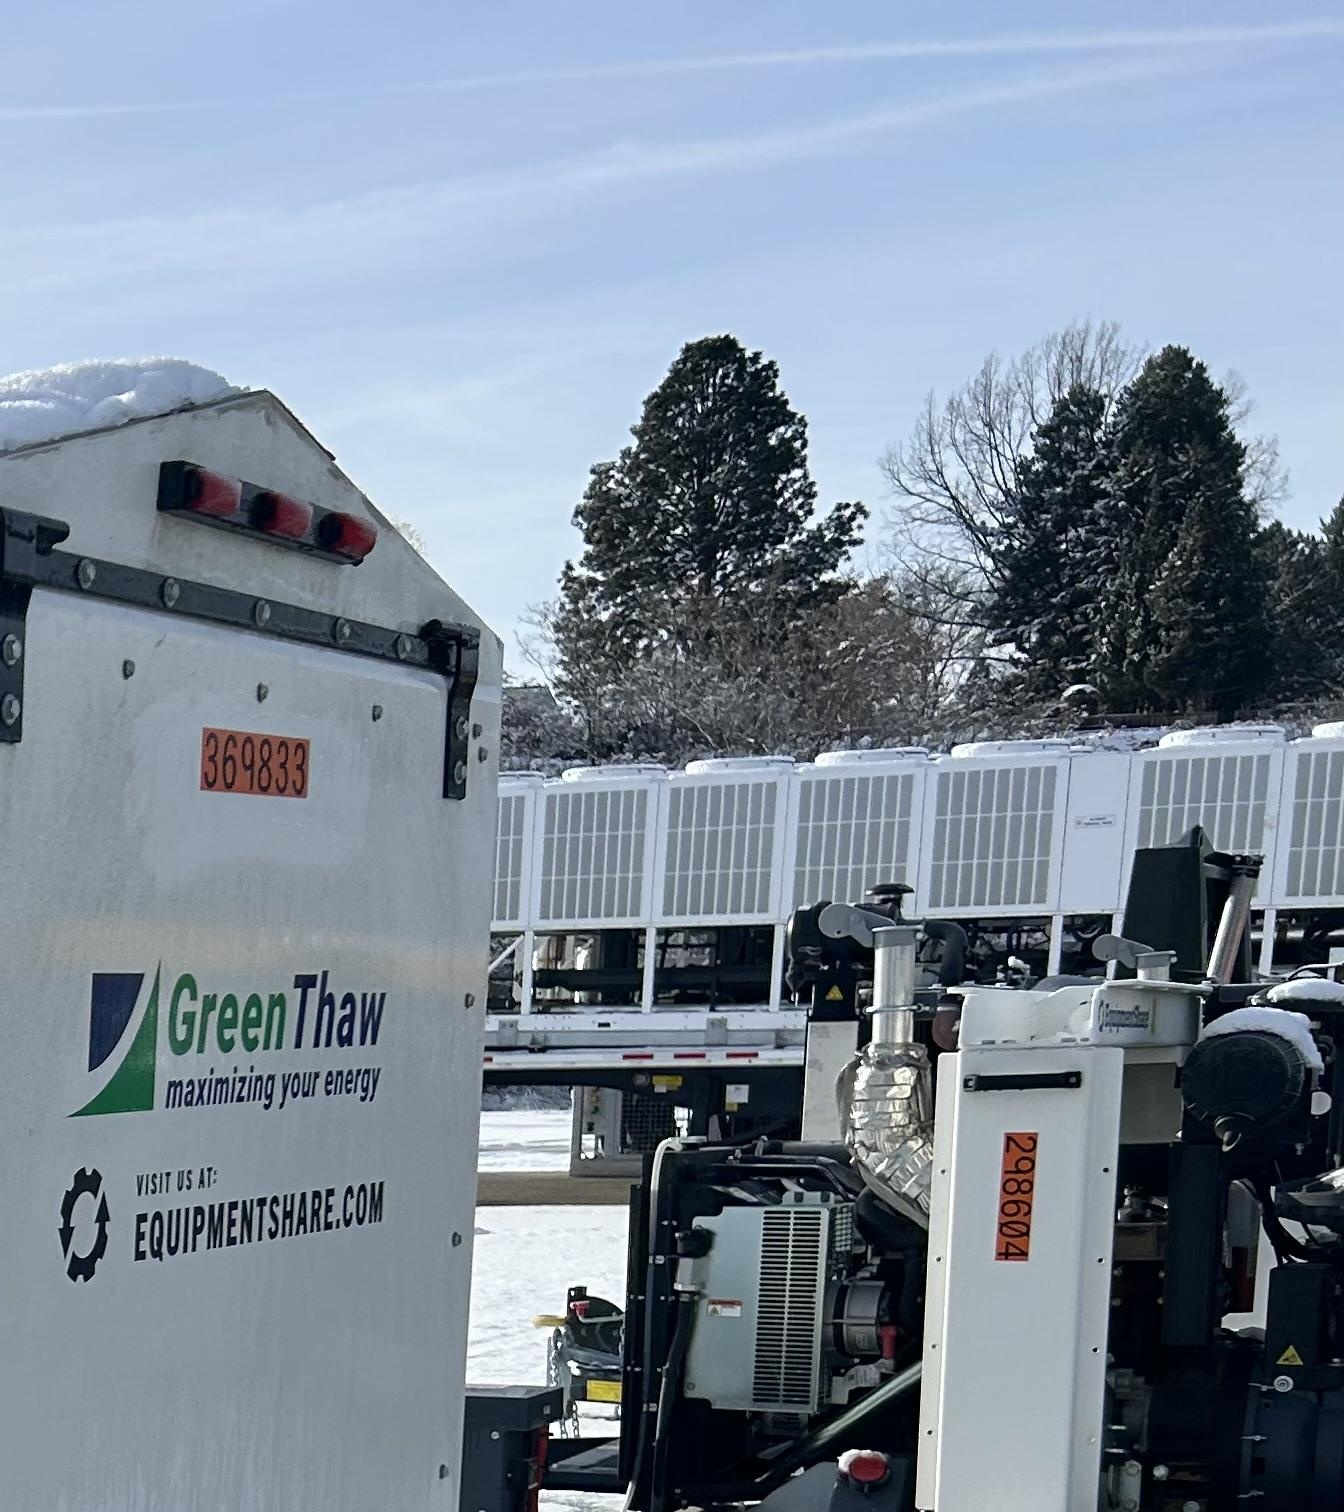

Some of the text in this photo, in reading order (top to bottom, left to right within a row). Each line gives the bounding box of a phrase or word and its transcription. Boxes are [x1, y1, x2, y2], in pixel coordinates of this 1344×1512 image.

[204, 732, 306, 795] 369833
[164, 1065, 382, 1111] maximizing your energy
[136, 1166, 217, 1197] VISIT US AT:
[998, 1135, 1037, 1260] 298604
[133, 1180, 385, 1262] EQUIPMENTSHARE.COM
